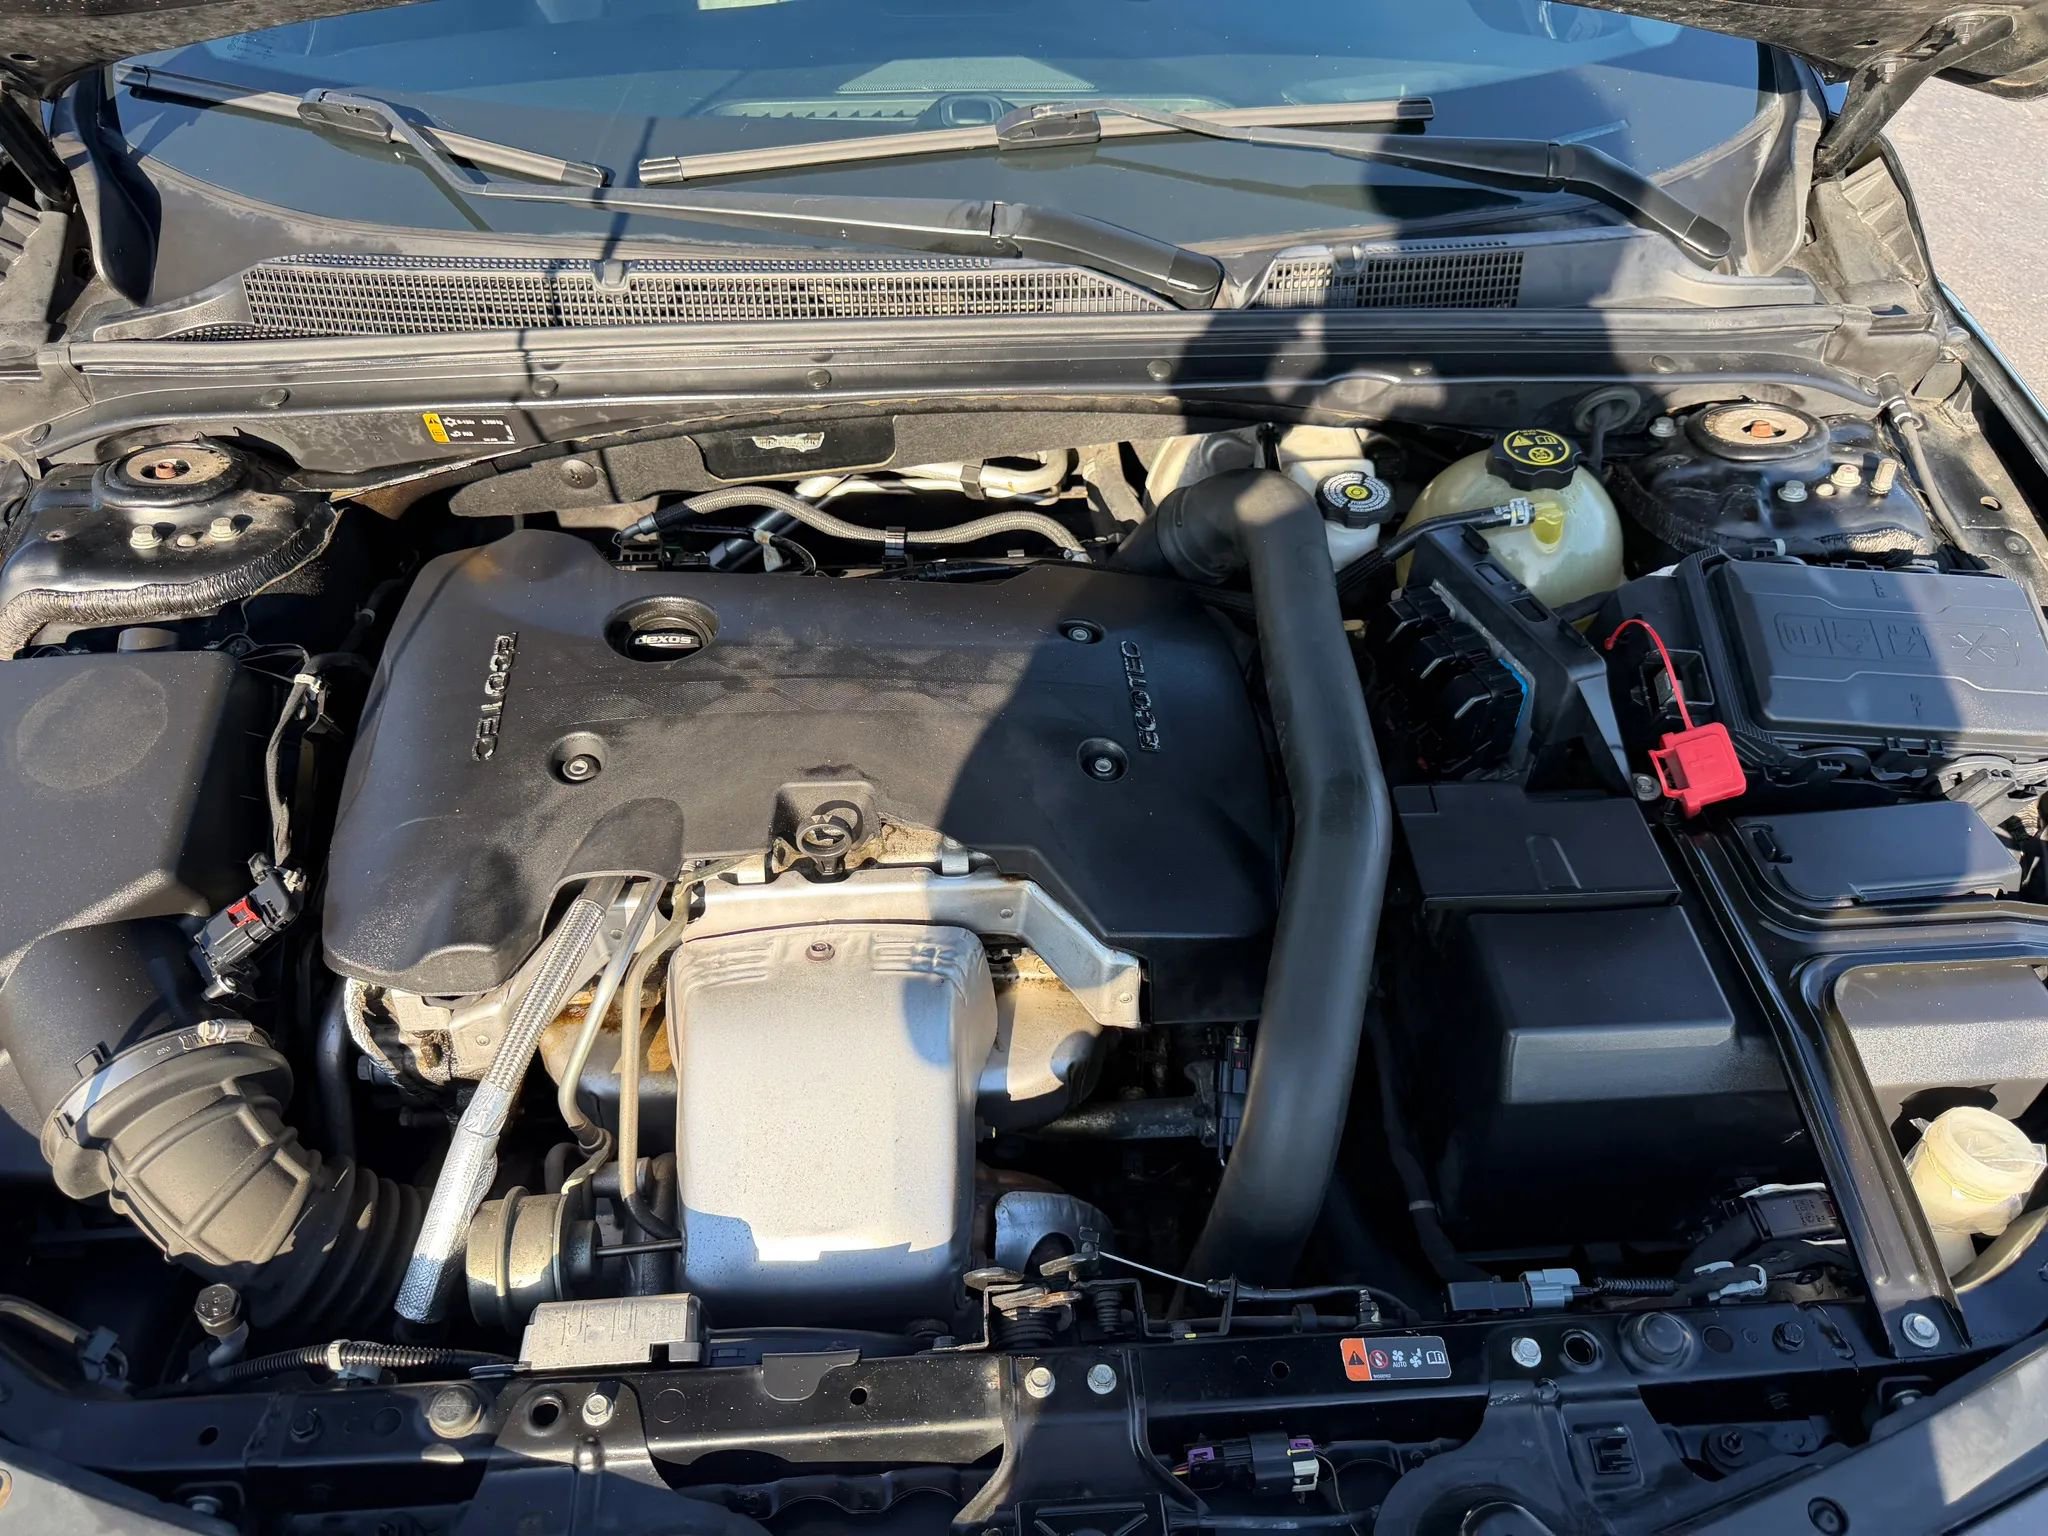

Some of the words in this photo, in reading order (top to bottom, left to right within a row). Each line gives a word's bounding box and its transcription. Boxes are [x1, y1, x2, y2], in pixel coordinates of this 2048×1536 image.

[634, 634, 692, 645] dexos
[472, 632, 518, 761] ECOTEC
[1121, 640, 1160, 751] ECOTEC
